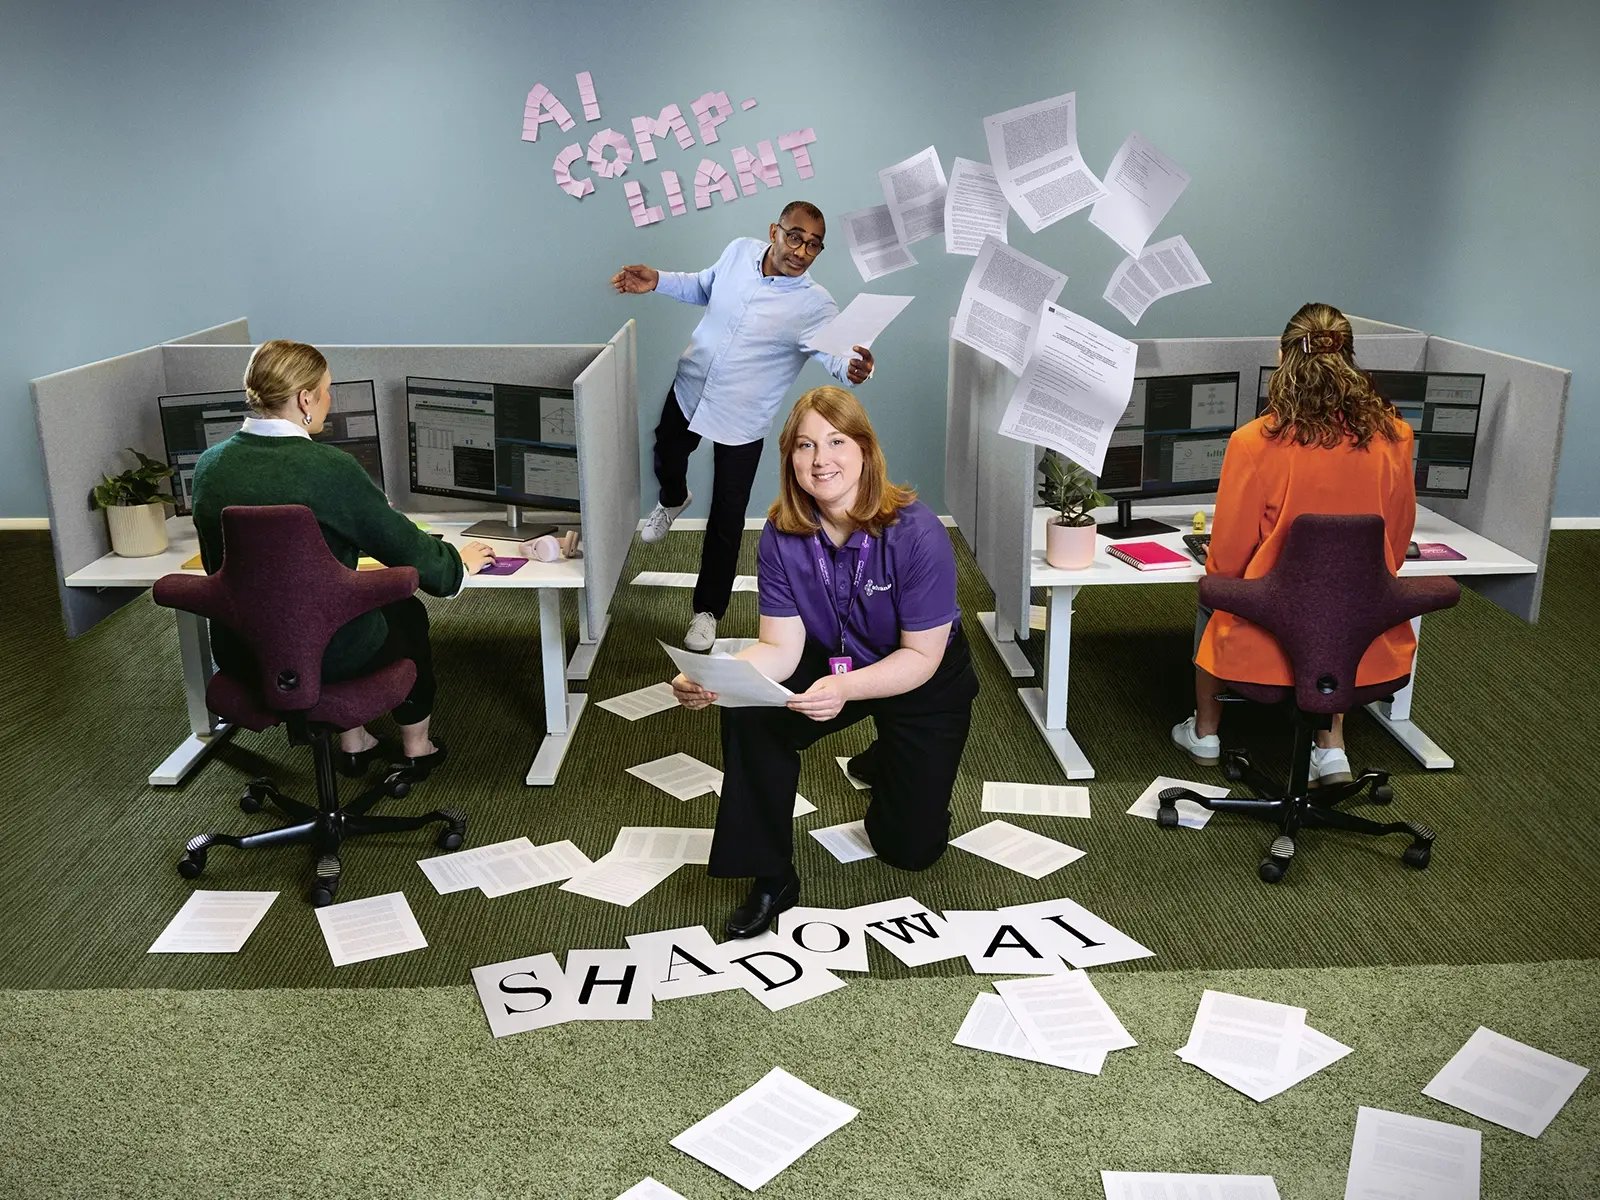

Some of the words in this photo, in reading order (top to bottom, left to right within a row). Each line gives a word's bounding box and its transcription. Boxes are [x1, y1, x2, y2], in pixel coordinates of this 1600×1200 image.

[521, 71, 601, 142] AI
[552, 91, 757, 198] COMP-
[623, 127, 817, 227] LIANT
[498, 912, 941, 1015] SHADOW
[983, 914, 1107, 958] AI
